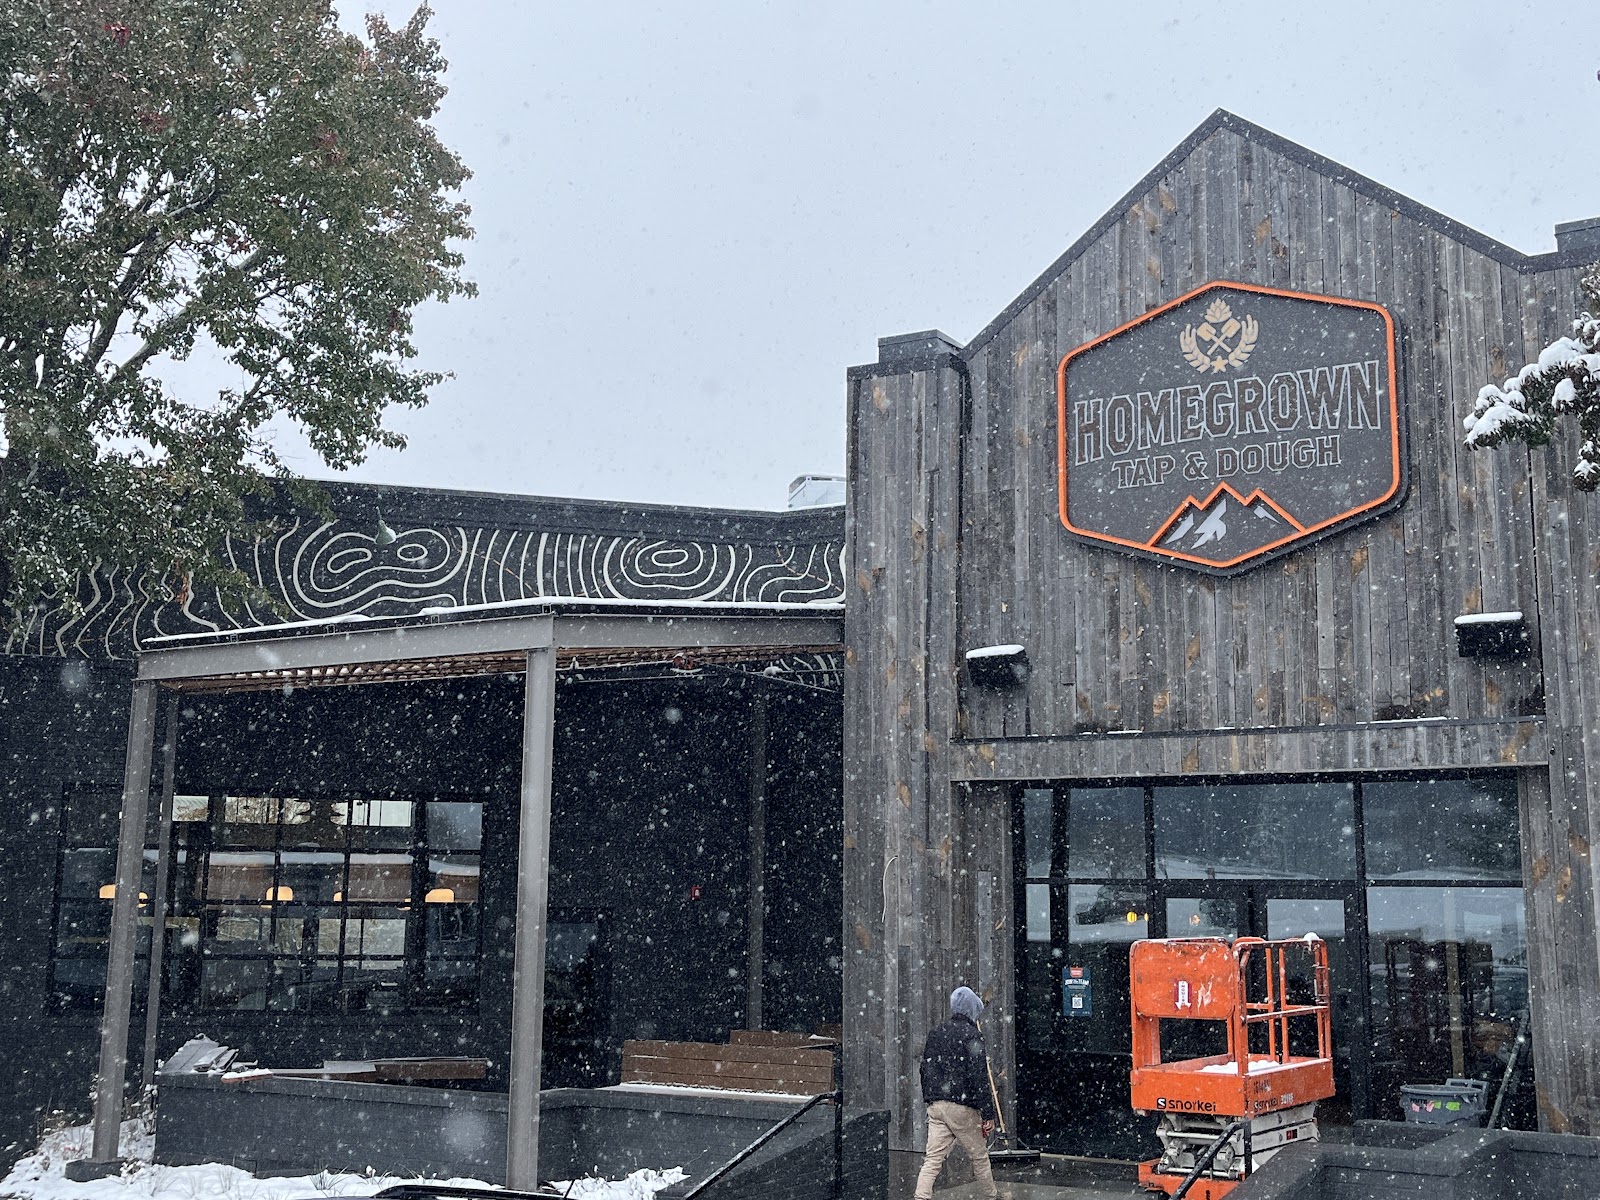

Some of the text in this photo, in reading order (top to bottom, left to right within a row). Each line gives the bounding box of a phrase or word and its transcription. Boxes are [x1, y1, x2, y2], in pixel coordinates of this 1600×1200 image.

[1075, 360, 1381, 466] HOMEGROWN
[1112, 435, 1341, 489] TAP & DOUGH
